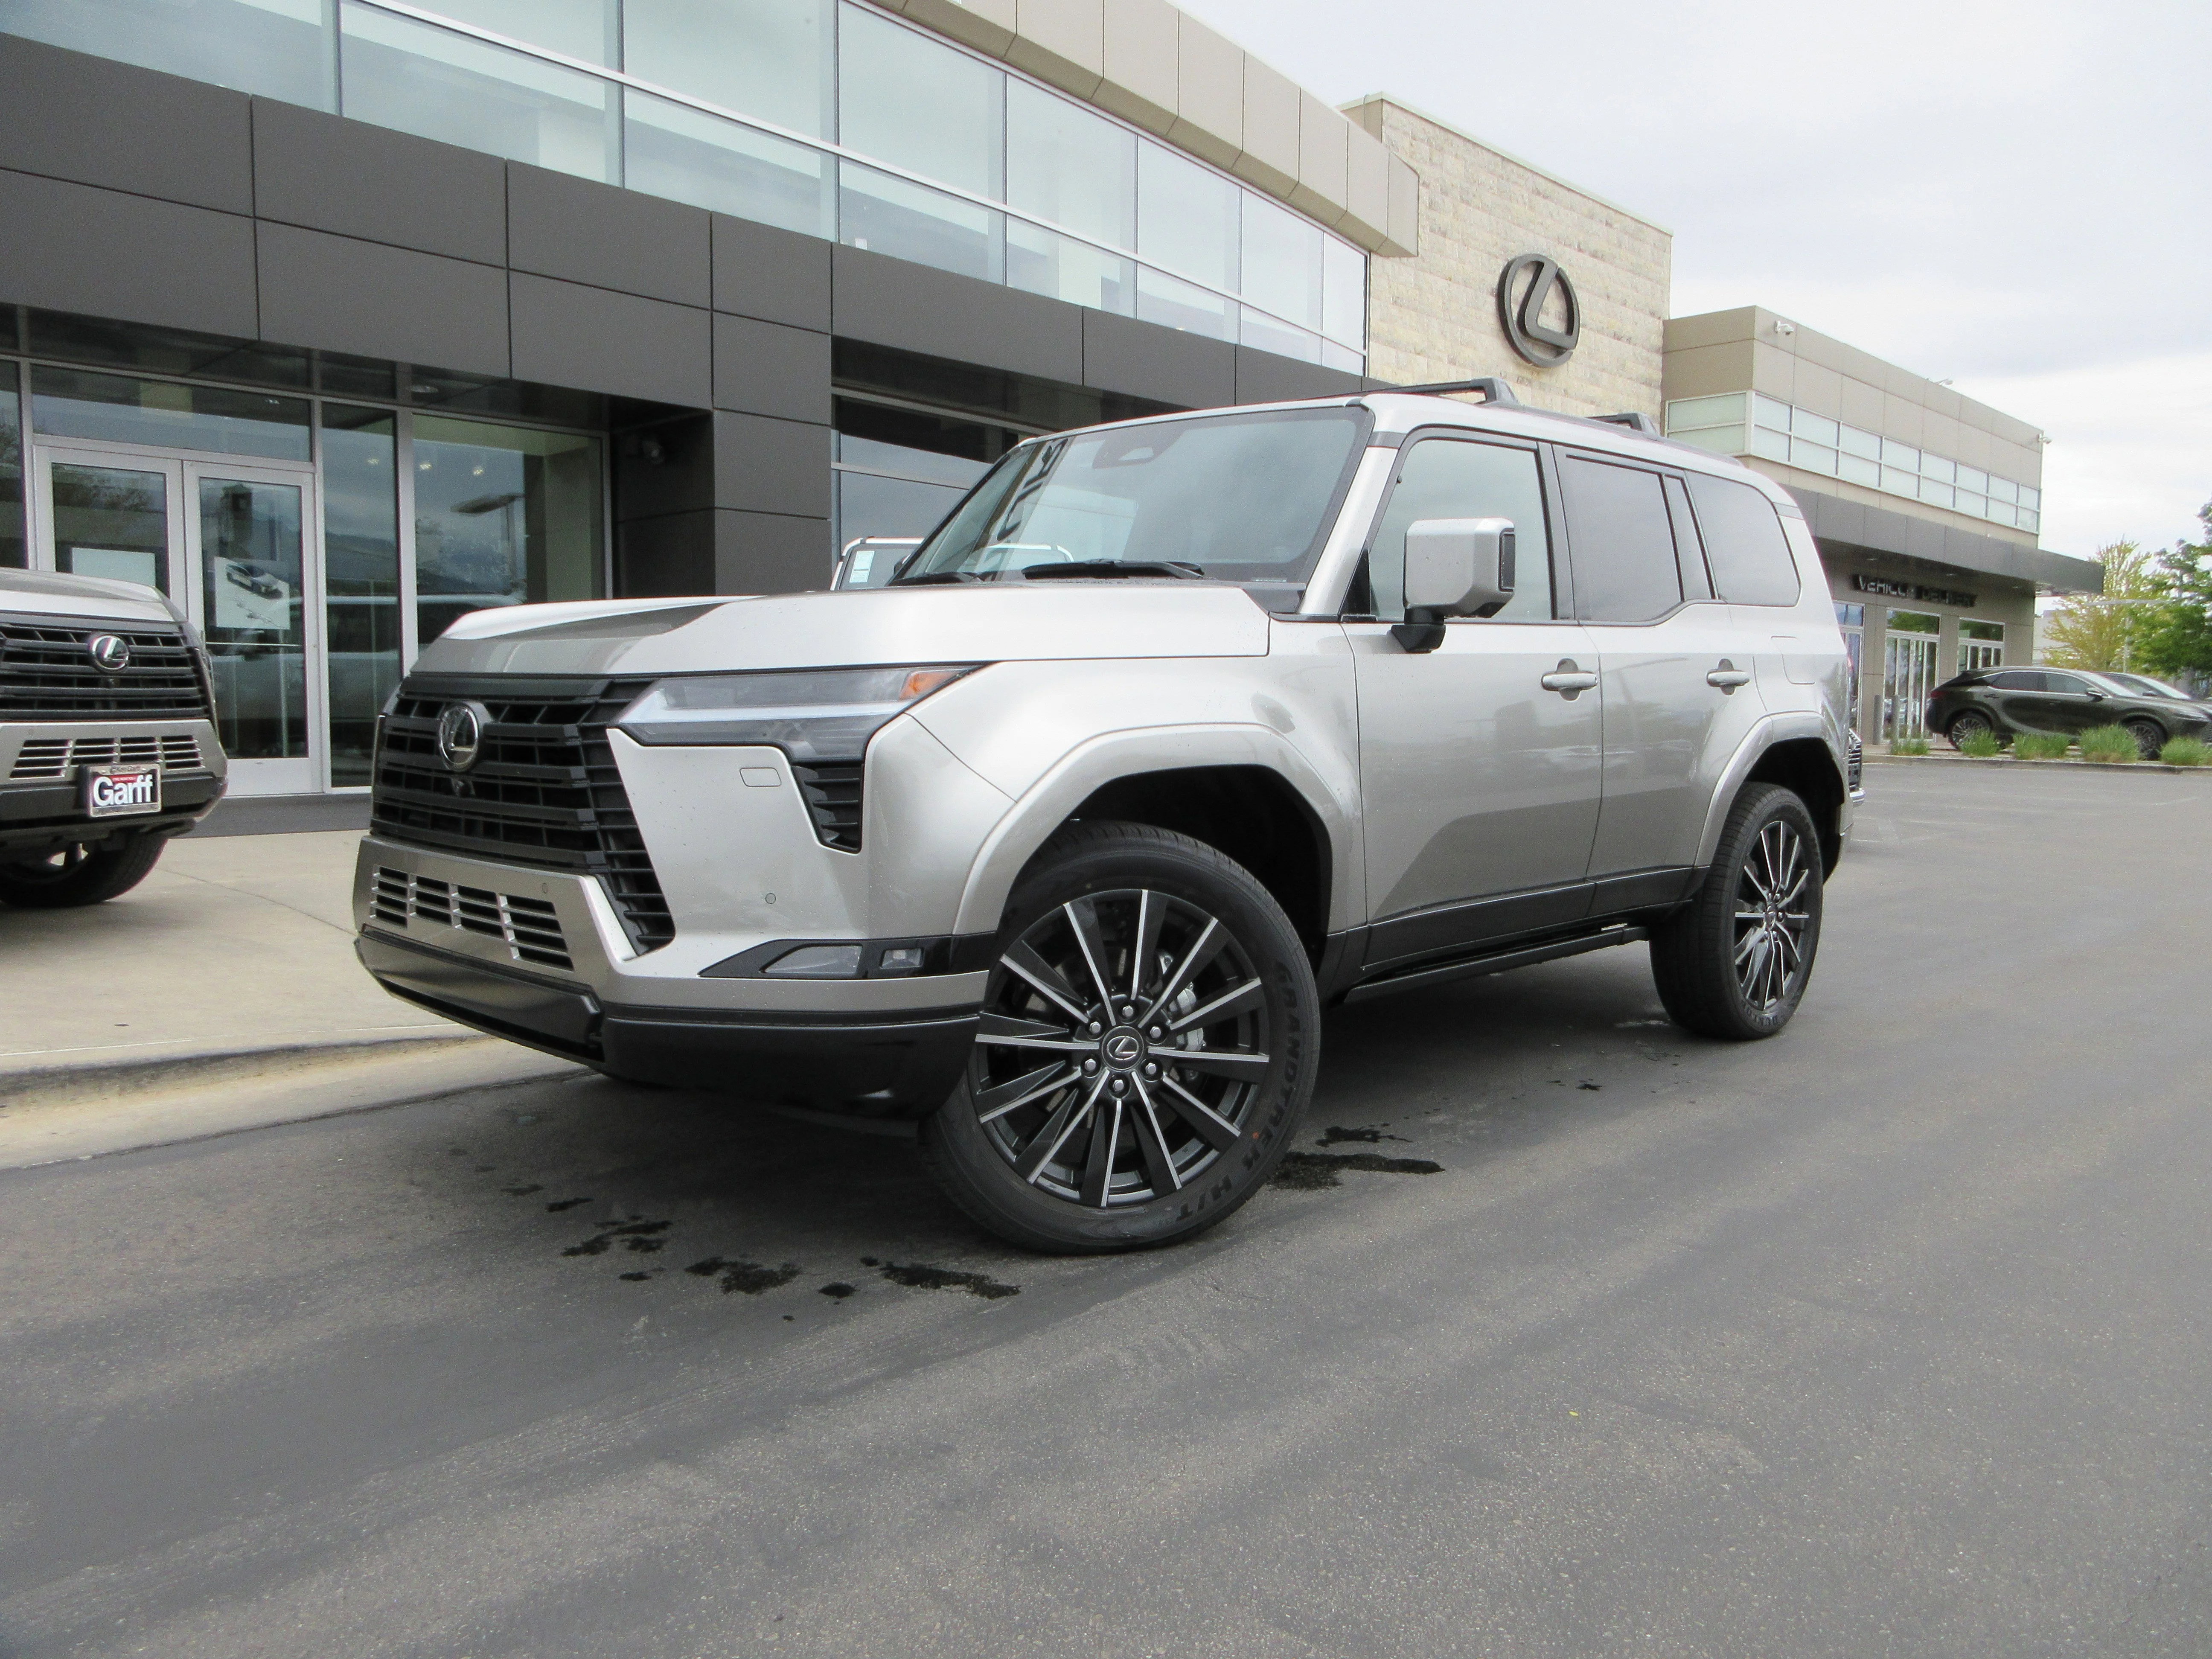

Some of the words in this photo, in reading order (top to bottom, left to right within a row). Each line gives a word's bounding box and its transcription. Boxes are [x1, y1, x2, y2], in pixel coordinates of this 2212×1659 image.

[93, 774, 153, 806] Garff
[1241, 961, 1301, 1170] GRANDTREK
[1175, 1175, 1233, 1222] H/T
